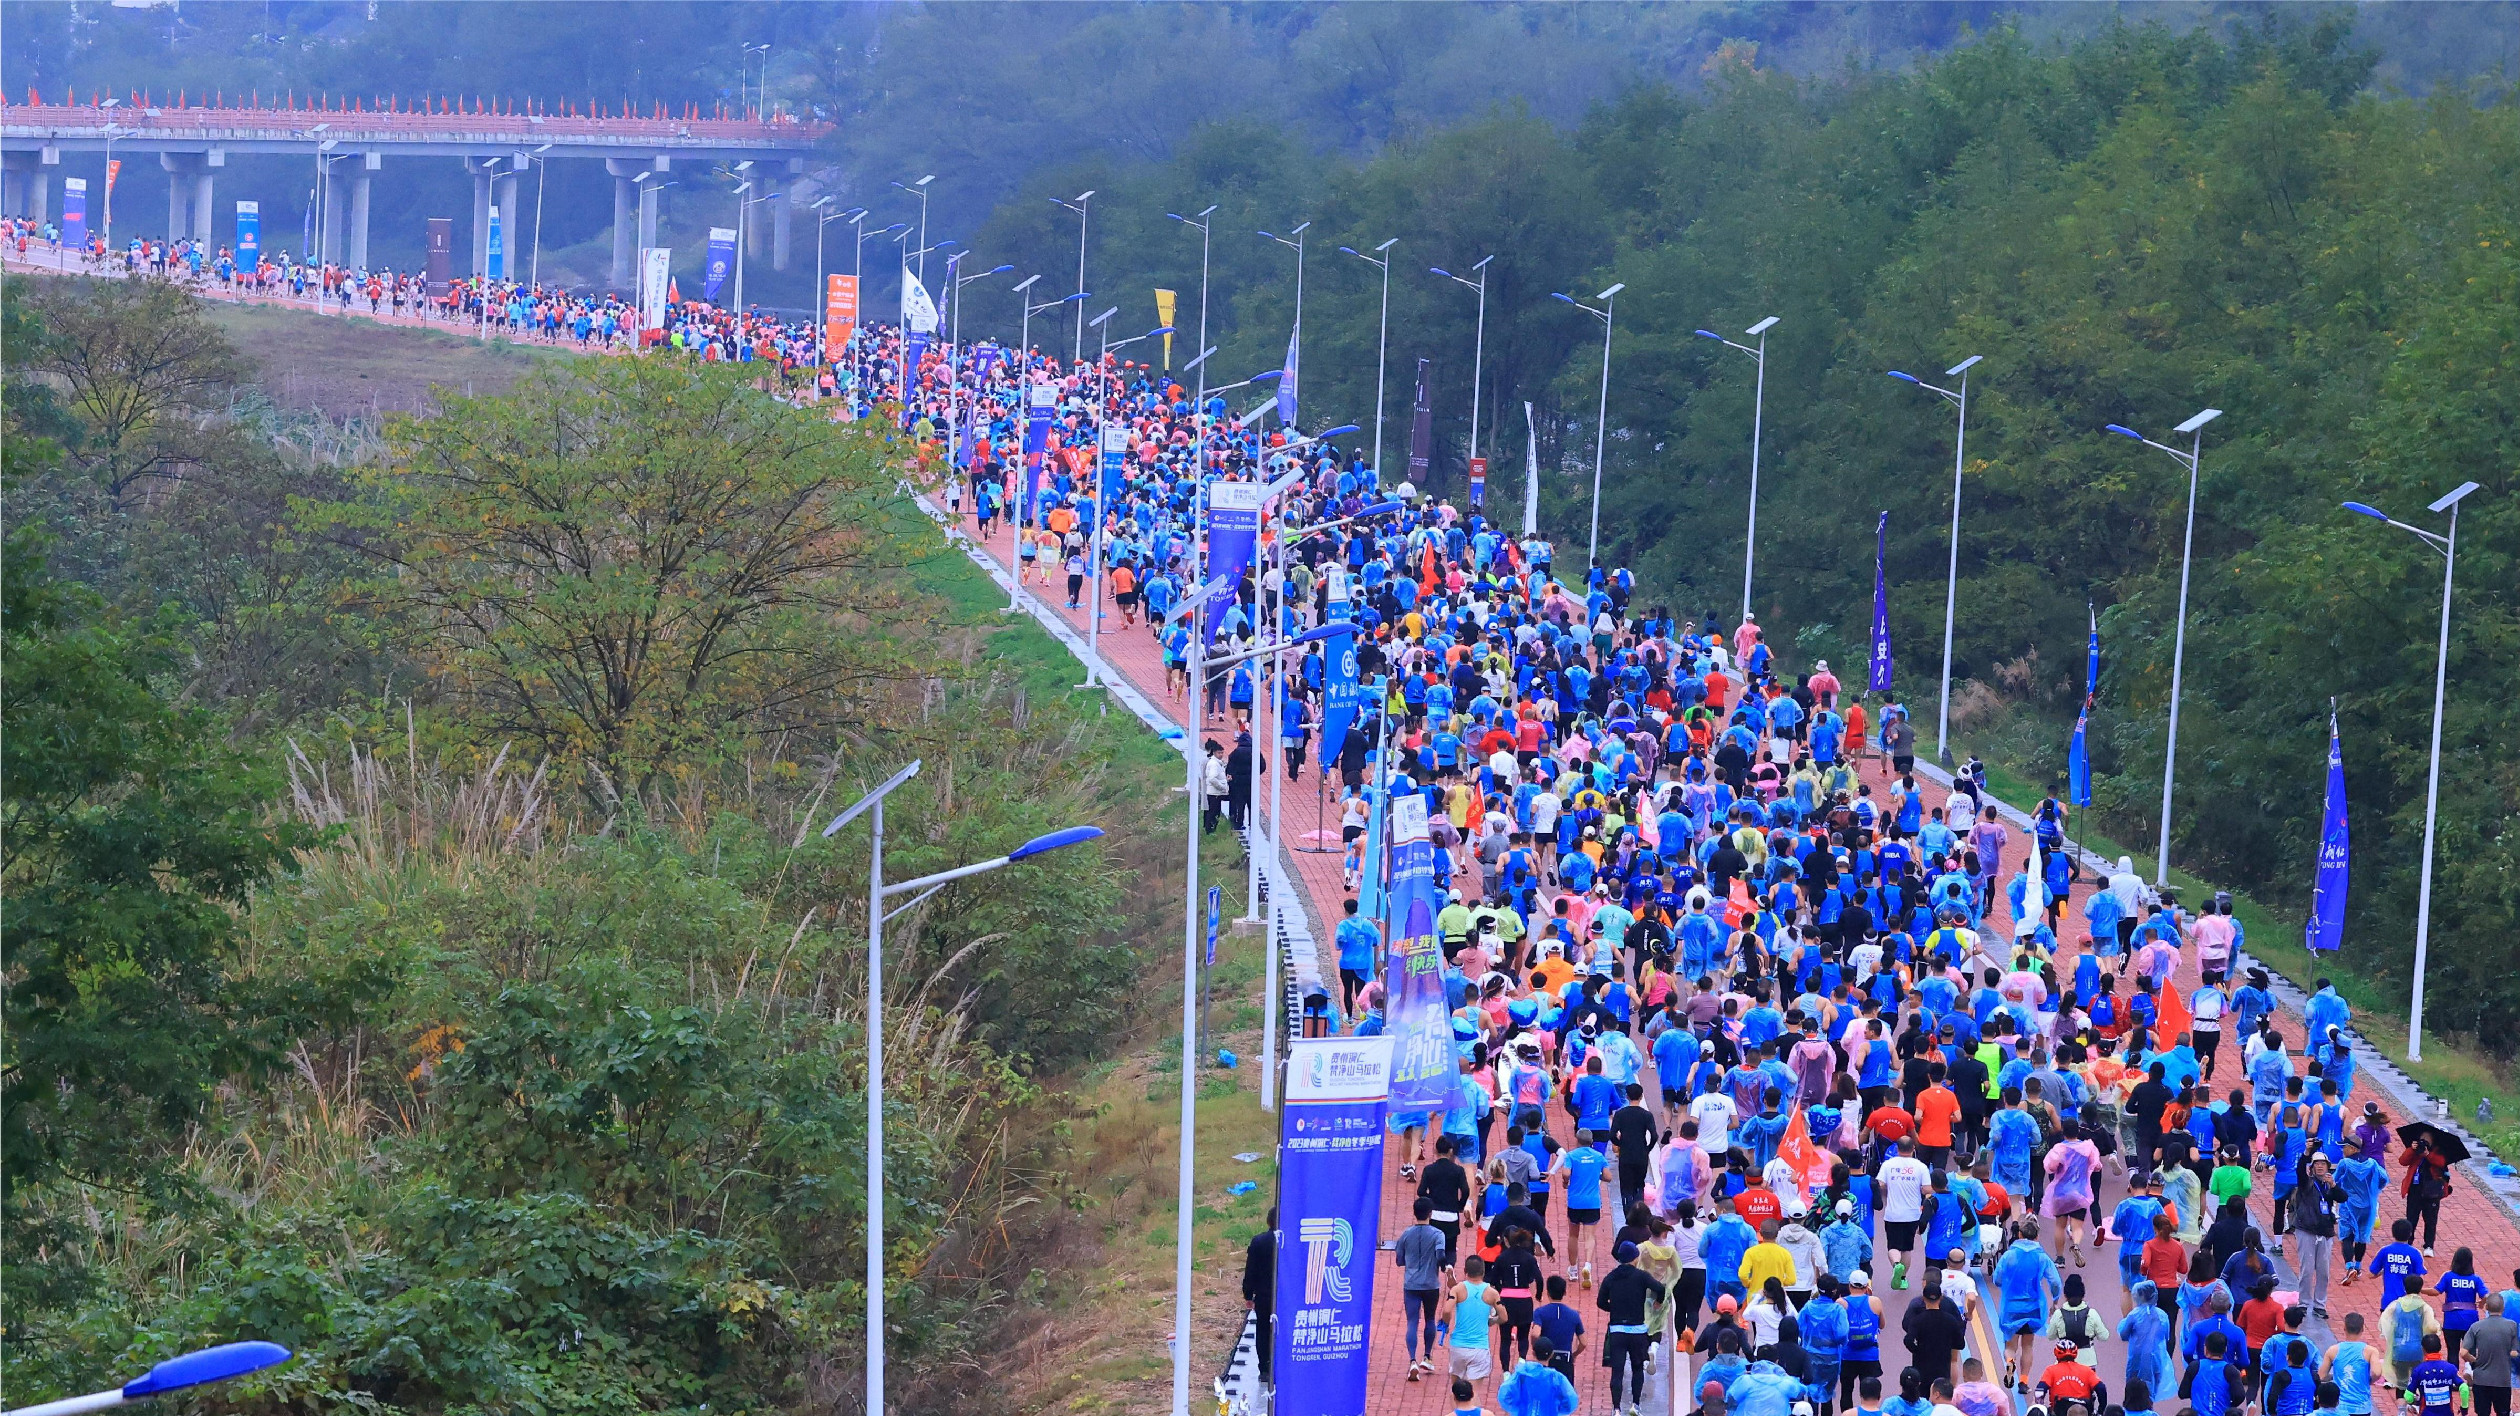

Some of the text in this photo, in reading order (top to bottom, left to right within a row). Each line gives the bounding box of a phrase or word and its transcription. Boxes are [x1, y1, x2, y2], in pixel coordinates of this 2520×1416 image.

[1816, 1114, 1836, 1126] 1:45
[2387, 1253, 2412, 1265] BIBA
[2451, 1278, 2475, 1289] BIBA
[1294, 1308, 1342, 1328] 贵州铜仁
[1292, 1324, 1363, 1346] 梵净山马拉松
[1322, 1352, 1349, 1360] GUIZHOU
